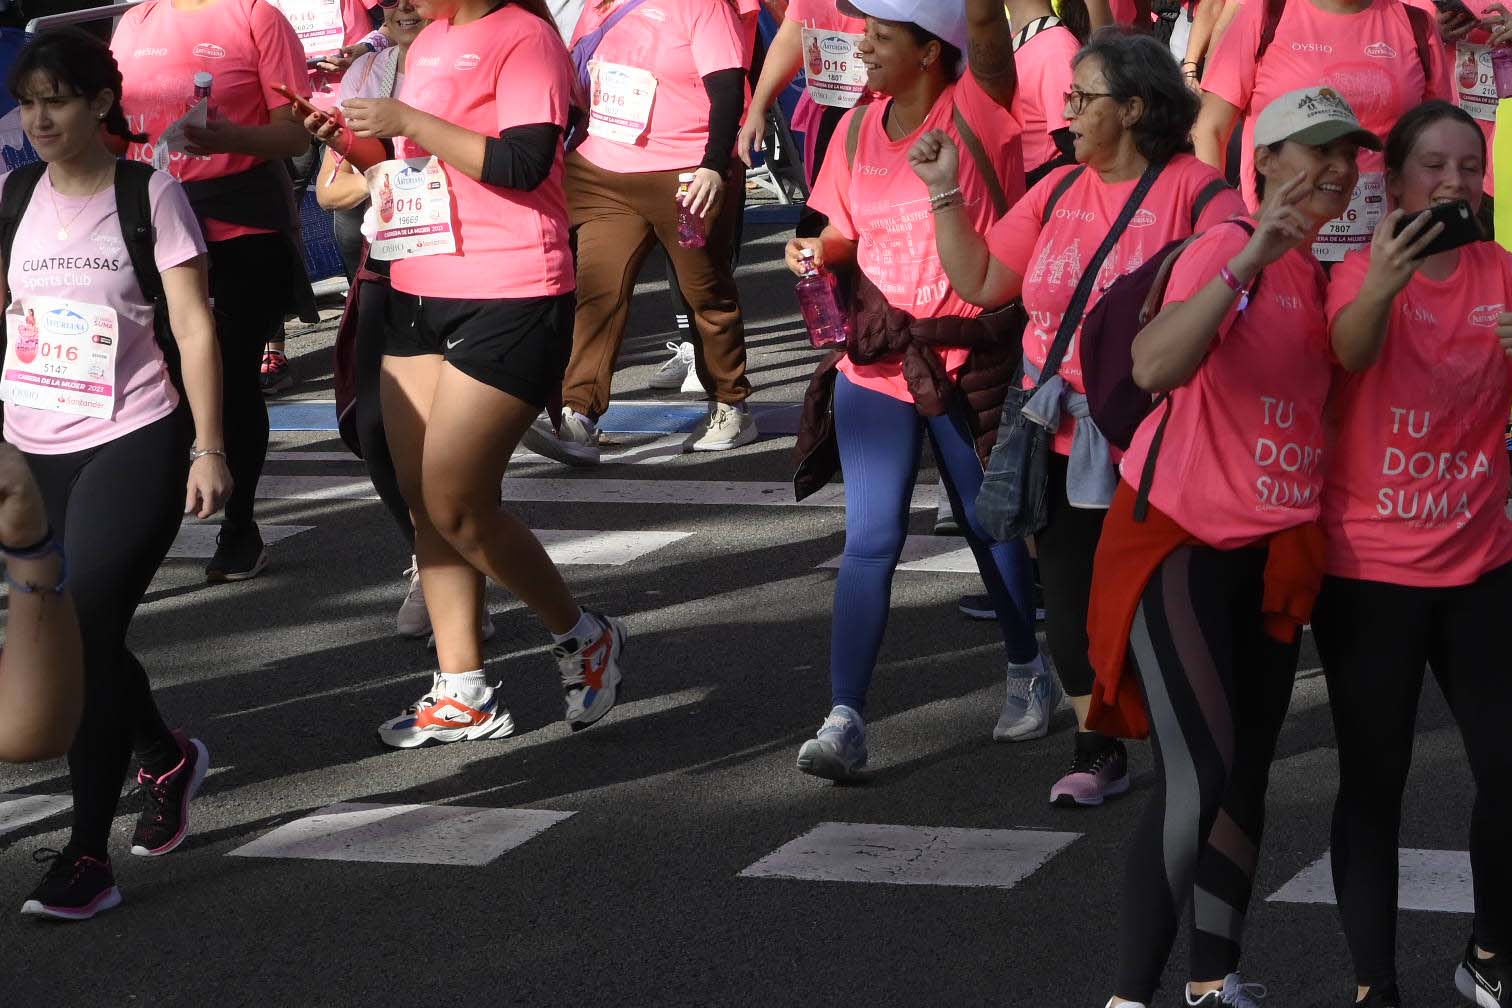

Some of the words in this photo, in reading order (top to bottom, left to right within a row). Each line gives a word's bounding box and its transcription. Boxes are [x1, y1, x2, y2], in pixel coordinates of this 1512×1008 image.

[824, 59, 847, 72] 016
[602, 92, 625, 107] 016
[396, 197, 422, 213] 016
[1329, 224, 1351, 233] 7807
[1330, 235, 1338, 243] DE
[1339, 235, 1346, 243] LA
[1347, 234, 1368, 243] MUJER
[22, 257, 120, 272] CUATRECASAS
[63, 273, 92, 287] Club
[916, 280, 947, 305] 2019
[41, 342, 79, 362] 016
[44, 363, 68, 376] 5147
[65, 395, 104, 409] Santander
[1261, 396, 1294, 428] TU
[1391, 407, 1431, 439] TU
[1382, 447, 1493, 480] DORSA
[1376, 488, 1471, 519] SUMA
